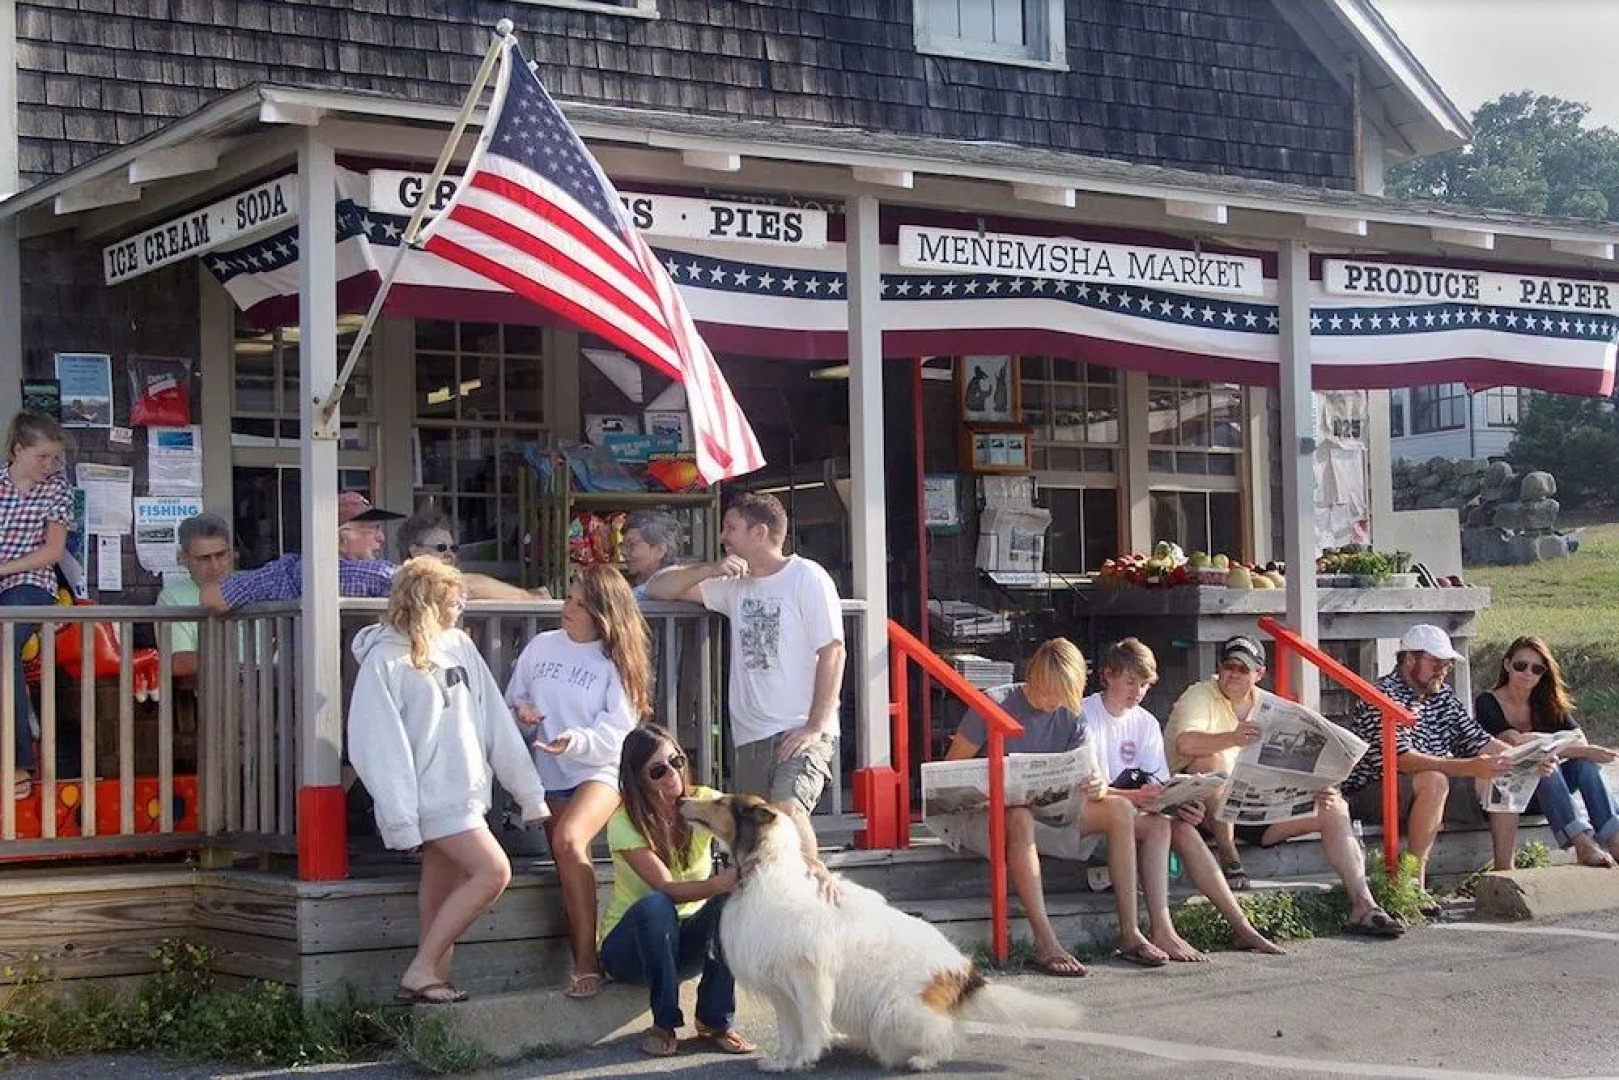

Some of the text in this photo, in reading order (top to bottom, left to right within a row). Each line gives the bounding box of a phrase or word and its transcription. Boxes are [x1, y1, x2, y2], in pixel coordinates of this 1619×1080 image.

[108, 184, 288, 278] ICE CREAM SODA
[709, 206, 804, 243] PIES
[917, 232, 1245, 289] MENEMSHA MARKET
[1343, 264, 1612, 310] PRODUCE PAPER
[138, 504, 199, 516] FISHING
[533, 661, 597, 690] CAPE MAY
